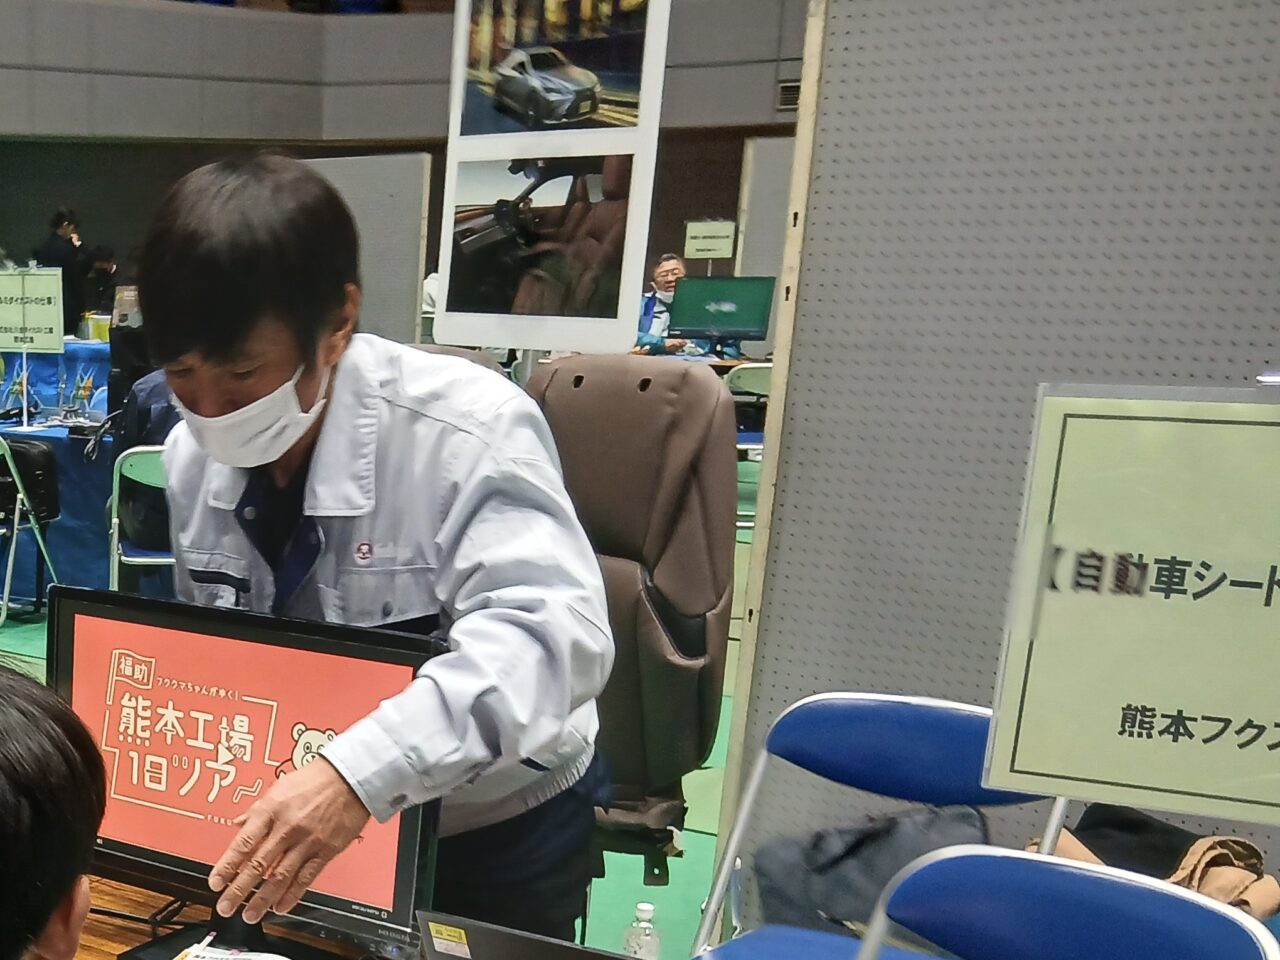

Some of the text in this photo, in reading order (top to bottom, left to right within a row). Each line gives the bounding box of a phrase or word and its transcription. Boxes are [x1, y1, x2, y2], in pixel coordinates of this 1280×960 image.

[119, 655, 148, 683] 福助
[118, 692, 254, 762] 熊本工場
